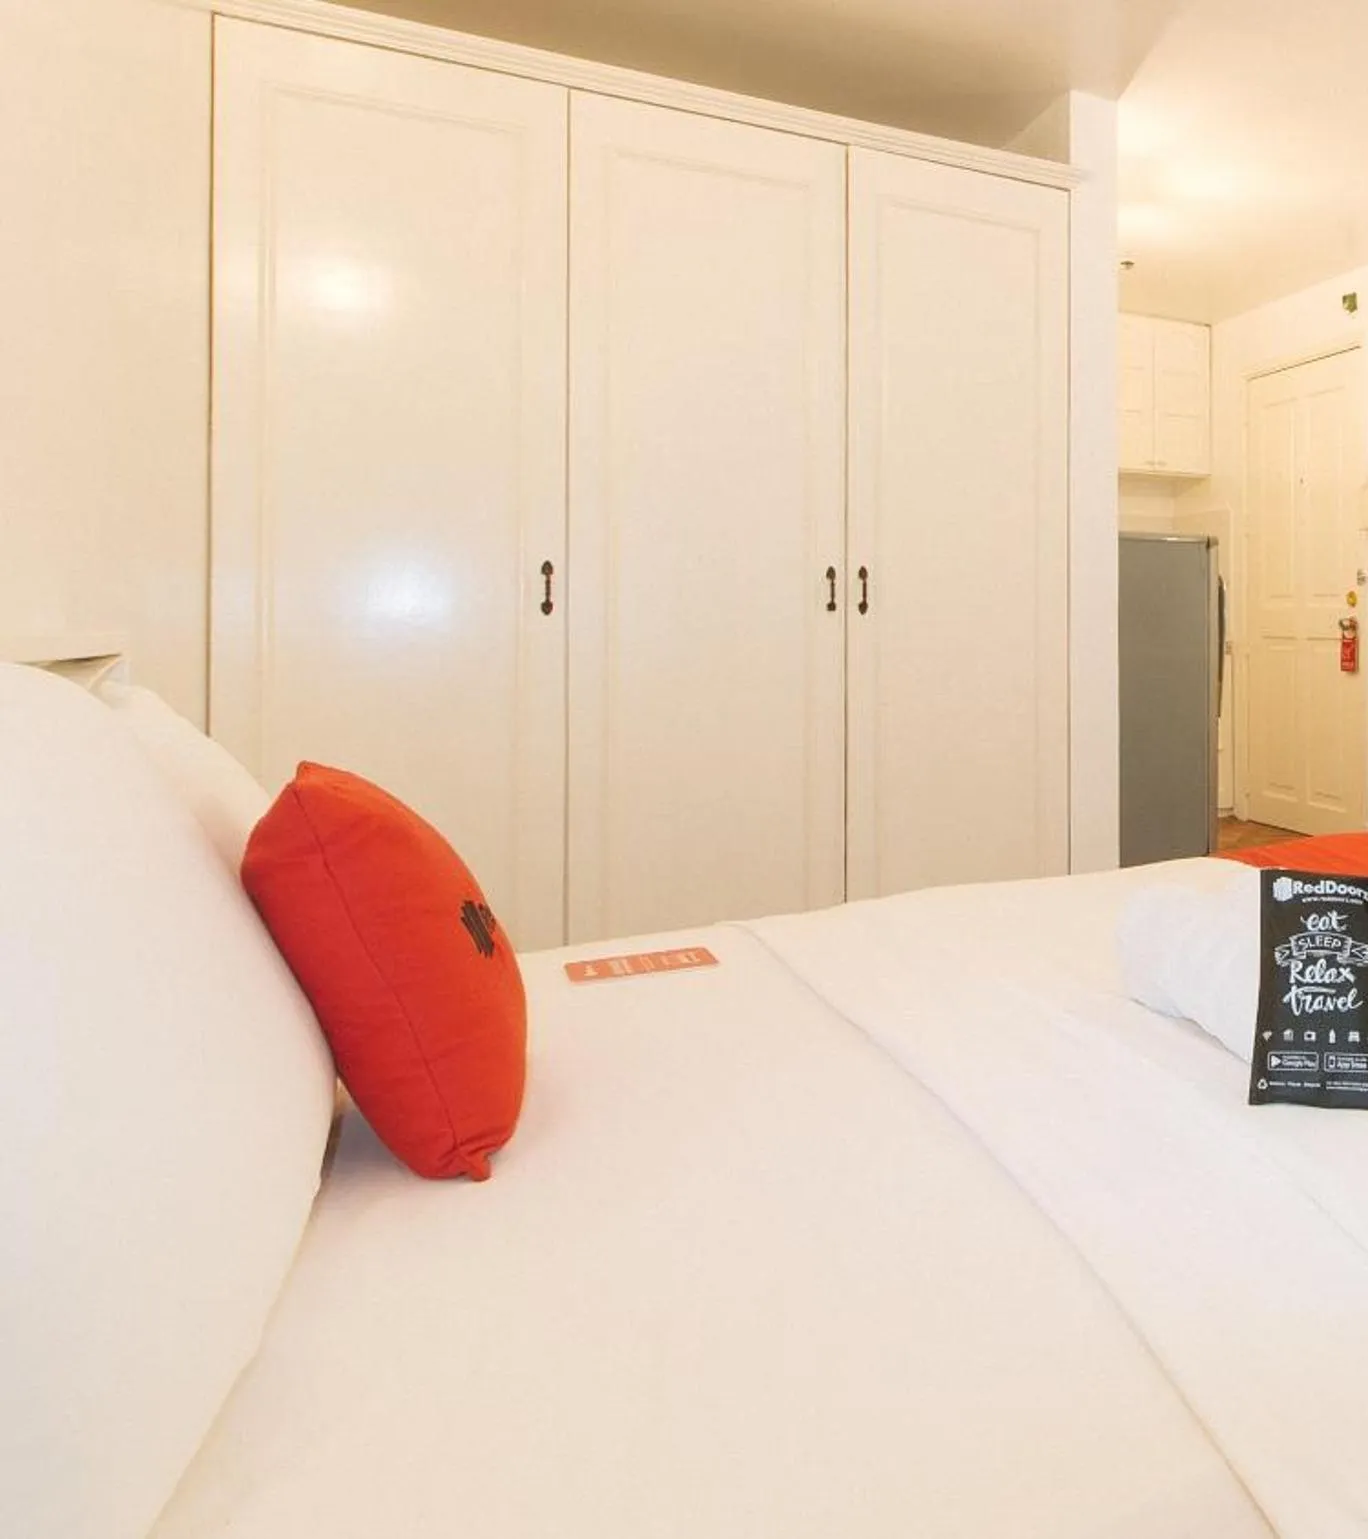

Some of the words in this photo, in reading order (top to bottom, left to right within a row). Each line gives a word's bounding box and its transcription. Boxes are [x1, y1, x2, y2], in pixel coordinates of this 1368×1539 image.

[1300, 910, 1348, 932] eat
[1298, 936, 1342, 949] SLEEP
[1288, 959, 1356, 983] Relax
